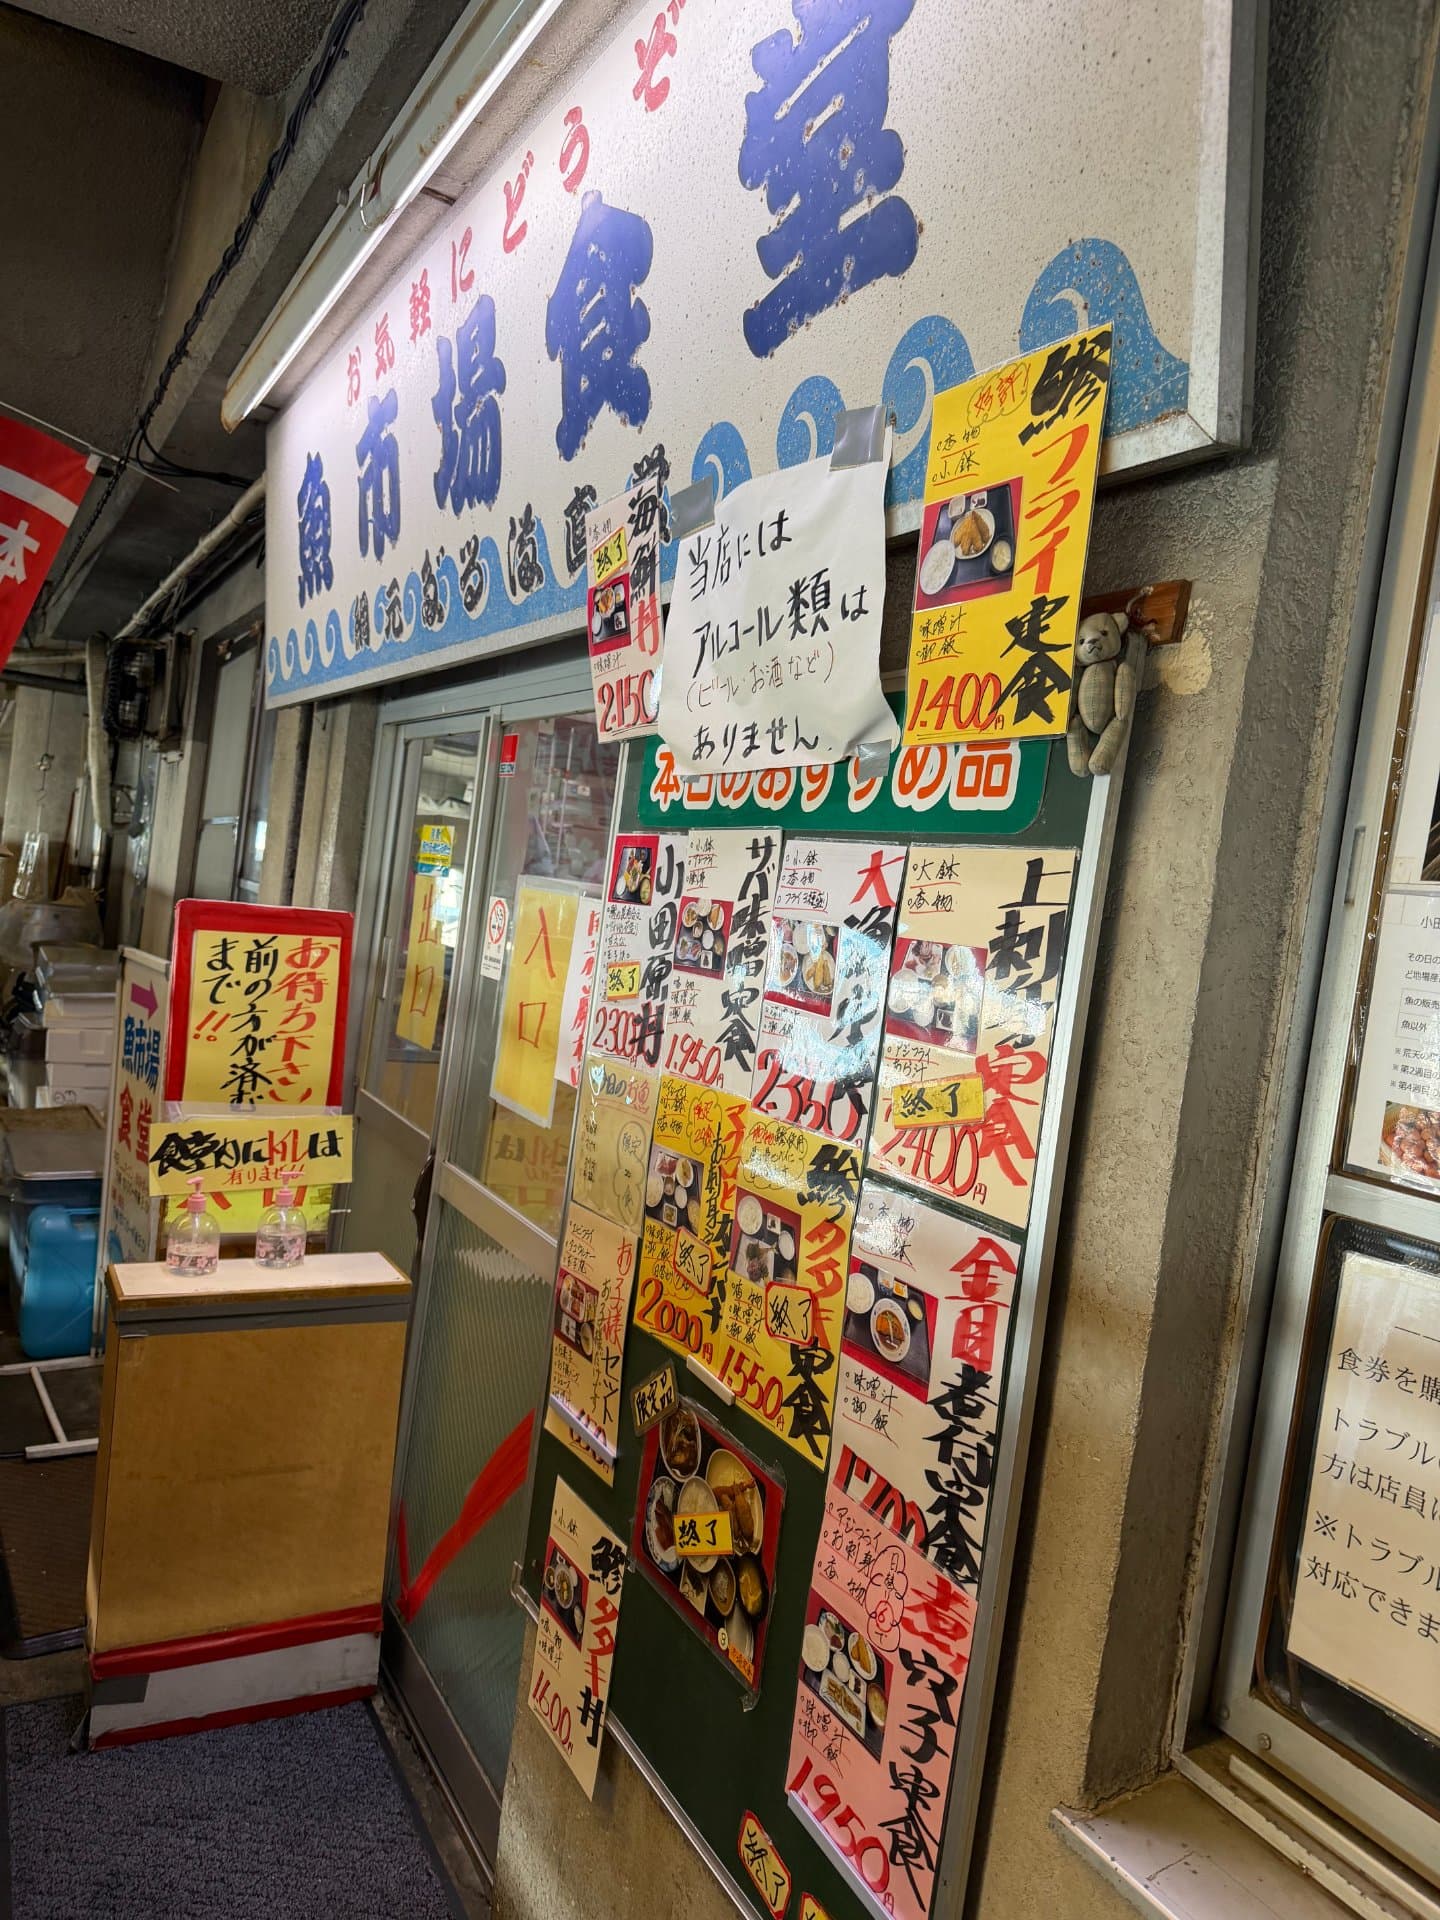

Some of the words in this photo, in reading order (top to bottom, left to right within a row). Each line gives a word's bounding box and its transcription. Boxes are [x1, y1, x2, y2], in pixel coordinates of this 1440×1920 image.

[346, 0, 688, 407] お気軽にどうぞ
[297, 0, 918, 608] 魚市場食堂
[597, 533, 624, 579] 終了
[628, 486, 661, 656] 海鮮丼
[688, 507, 793, 602] 当店には
[692, 568, 869, 678] アルコール類は
[410, 884, 438, 1017] 出口
[519, 906, 557, 1049] 入口
[608, 967, 637, 993] 終了
[629, 843, 685, 1067] 小田原丼
[715, 835, 776, 1072] サバ味噌定食
[1405, 969, 1440, 985] ど地場産
[122, 1015, 161, 1095] 魚市場
[266, 937, 339, 1104] お待ち下さい
[1401, 1019, 1428, 1033] 魚以外
[118, 1082, 151, 1165] 食堂
[901, 1083, 961, 1118] 終了
[769, 1297, 813, 1337] 終了
[1334, 1406, 1440, 1468] トラブル
[679, 1518, 718, 1548] 終了
[1303, 1555, 1440, 1645] 対応できま
